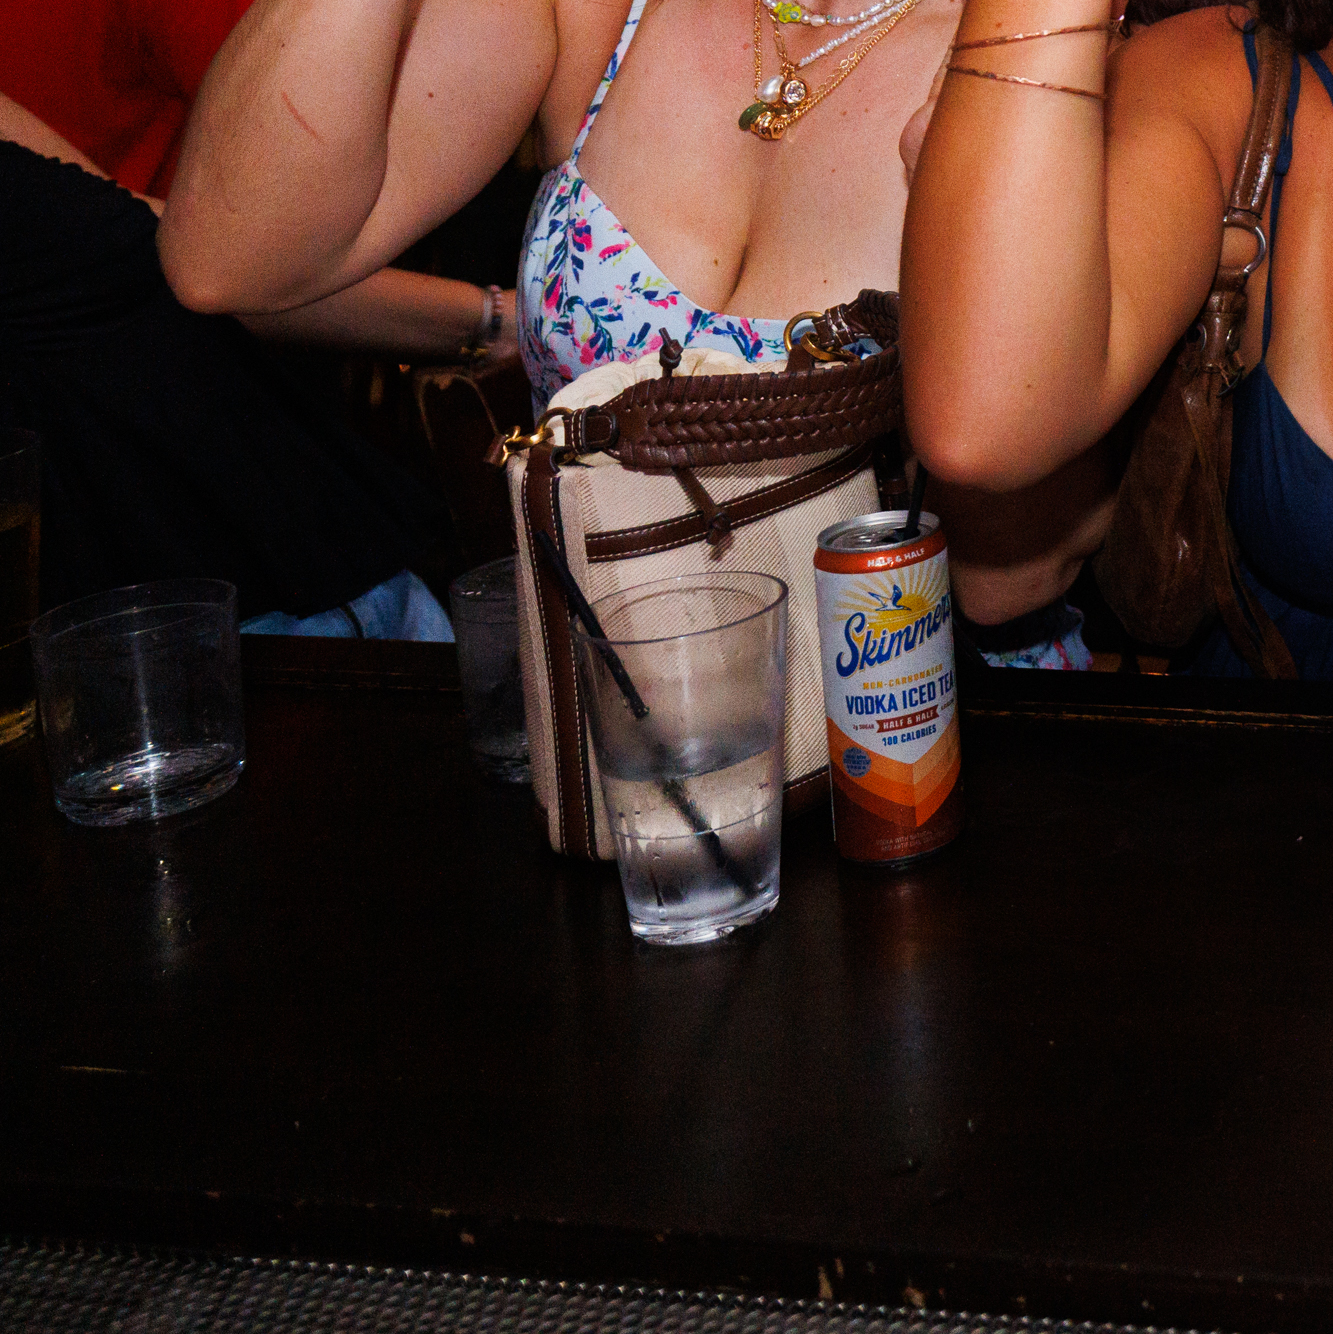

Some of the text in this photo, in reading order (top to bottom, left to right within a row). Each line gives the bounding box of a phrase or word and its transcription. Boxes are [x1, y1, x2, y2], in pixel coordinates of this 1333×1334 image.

[867, 547, 926, 568] HALF & HALF
[863, 664, 943, 690] NON-CARBONATED
[845, 691, 899, 716] VODKA
[902, 682, 936, 710] ICED
[938, 670, 955, 696] TEA
[883, 710, 935, 730] HALF & HALF
[881, 724, 937, 747] 100 CALORIES
